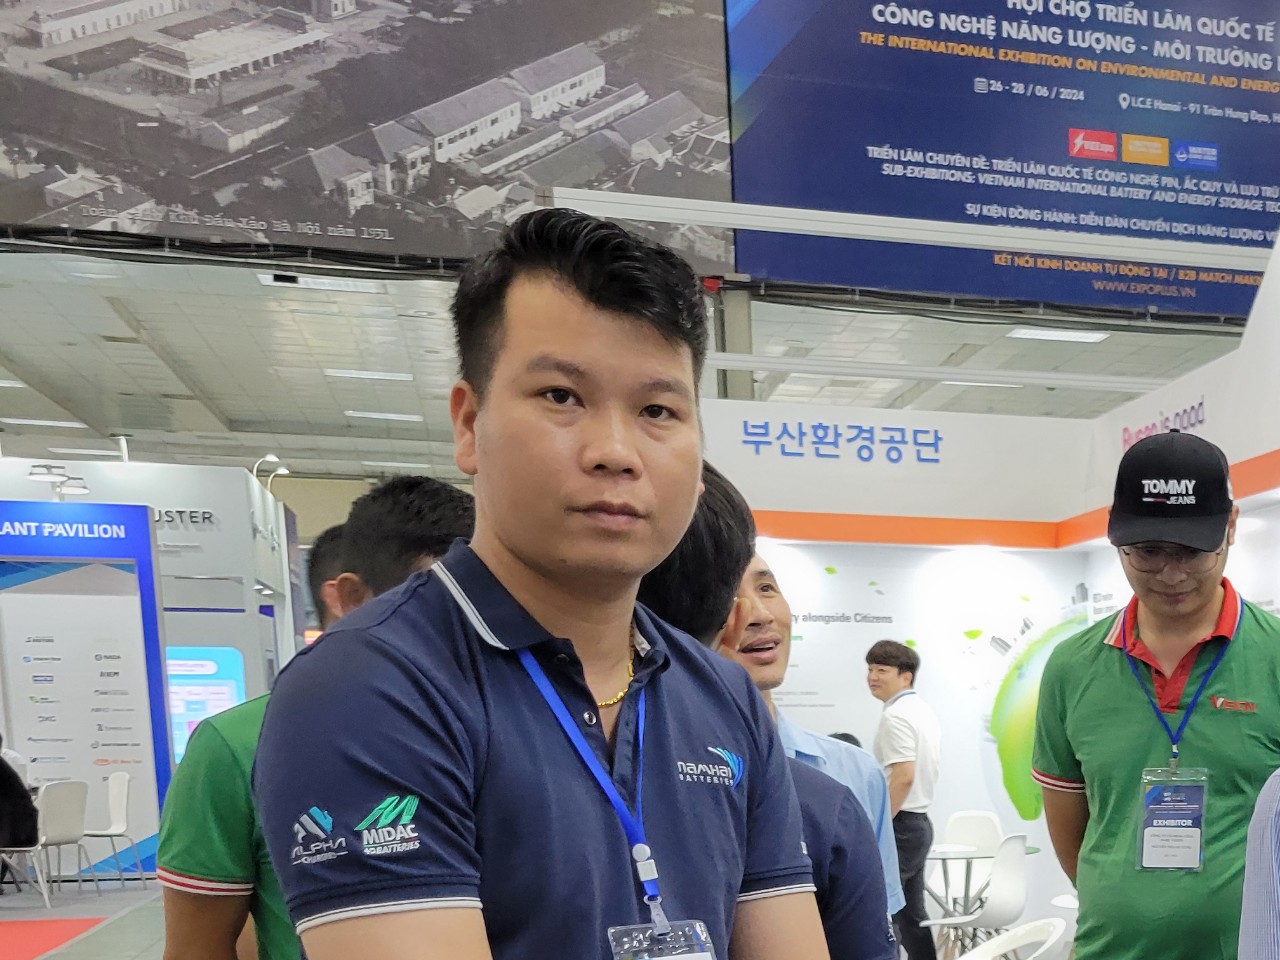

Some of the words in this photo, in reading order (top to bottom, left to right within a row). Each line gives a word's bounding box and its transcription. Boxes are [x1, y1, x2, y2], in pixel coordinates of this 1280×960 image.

[1095, 1, 1149, 26] TRIỂN
[1153, 8, 1192, 32] LÃM
[1197, 16, 1251, 40] QUỐC
[1255, 21, 1277, 42] TẾ
[872, 3, 935, 28] CÔNG
[940, 13, 997, 40] NGHỆ
[1002, 20, 1063, 45] NĂNG
[1068, 29, 1136, 54] LƯỢNG
[1153, 40, 1192, 61] MÔI
[1196, 45, 1273, 70] TRƯỜNG
[859, 31, 885, 46] THE
[888, 35, 995, 60] INTERNATIONAL
[998, 48, 1073, 68] EXHIBITION
[1075, 58, 1097, 72] ON
[1100, 61, 1206, 85] ENVIRONMENTAL
[1210, 74, 1238, 89] AND
[989, 80, 1003, 91] 26
[1011, 82, 1025, 94] 28
[1034, 85, 1049, 97] 06
[1059, 88, 1085, 100] 2024
[741, 420, 943, 464] 부산환경공단
[1141, 479, 1196, 495] TOMMY
[1166, 496, 1196, 505] JEANS
[43, 522, 126, 538] PAVILION
[802, 612, 851, 625] alongside
[854, 613, 893, 623] Citizens
[678, 774, 734, 787] BATTERIES
[362, 824, 419, 845] MIDAC
